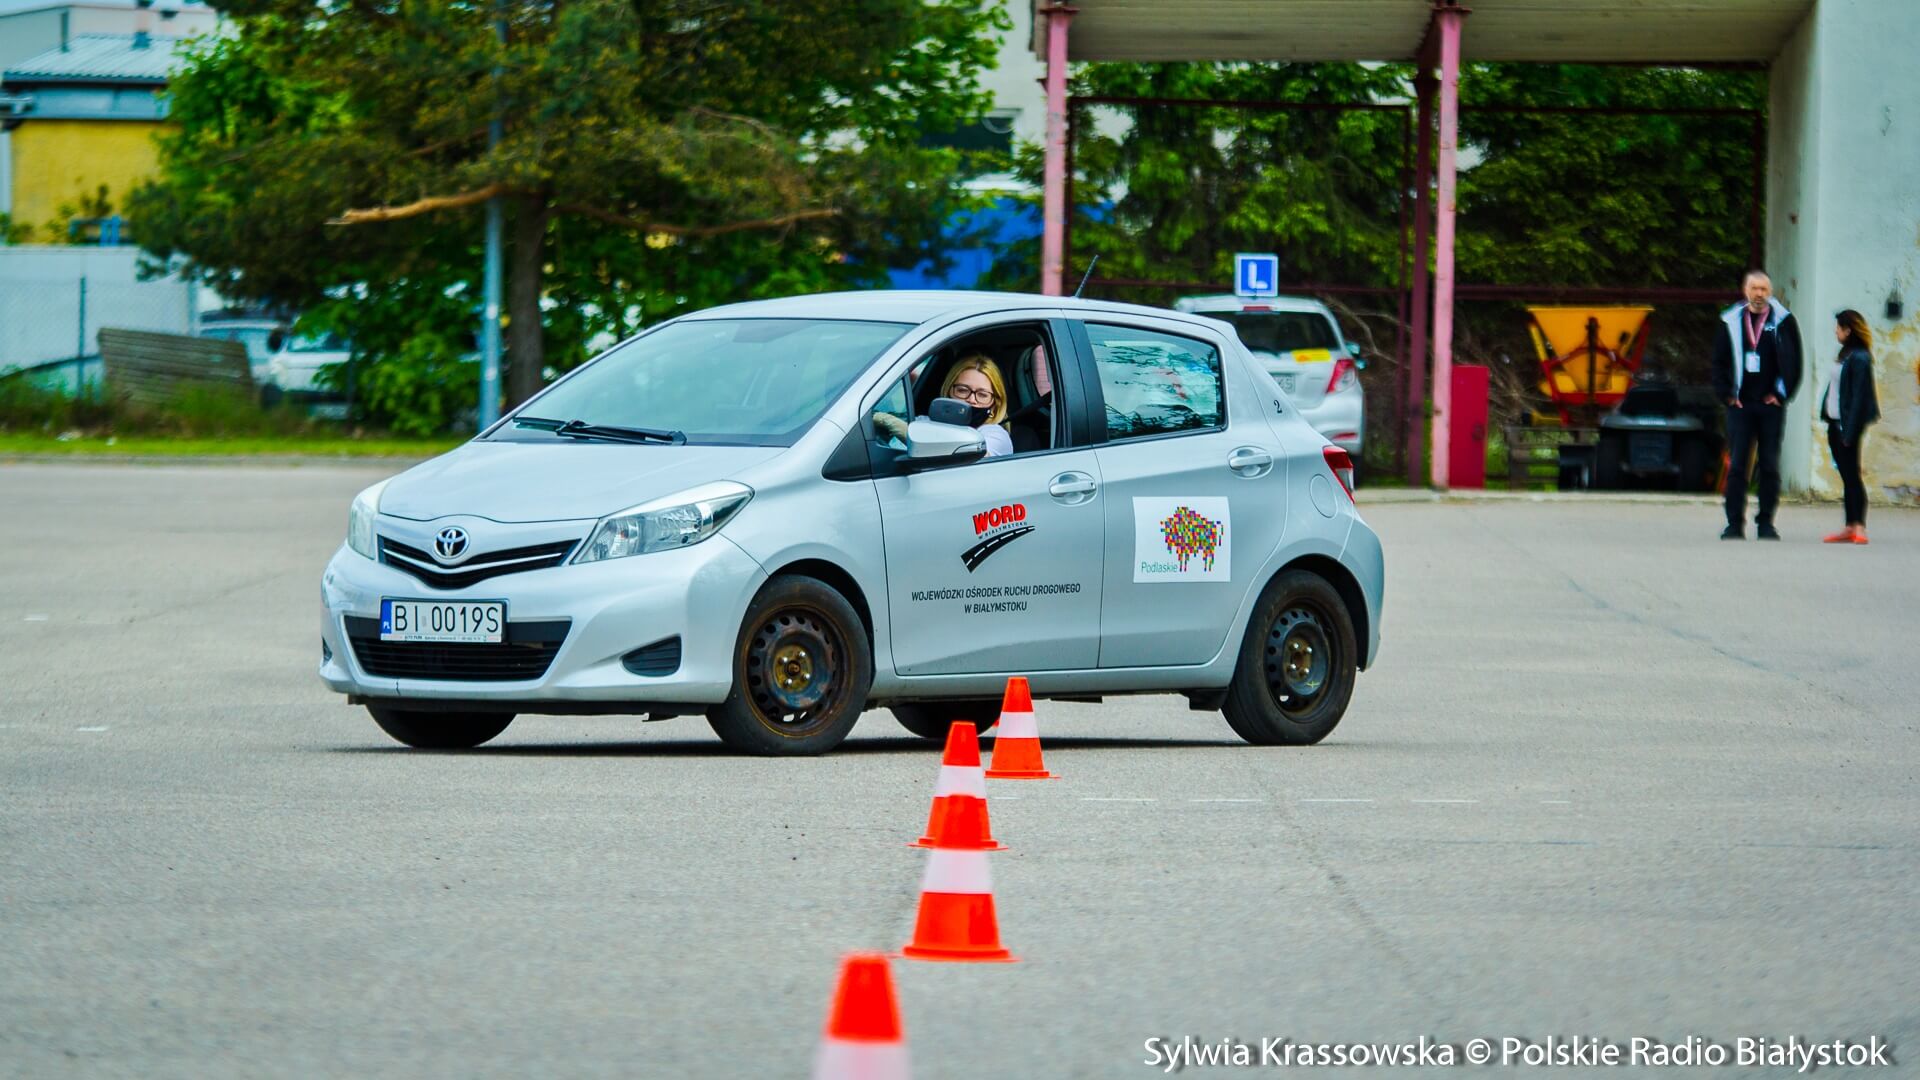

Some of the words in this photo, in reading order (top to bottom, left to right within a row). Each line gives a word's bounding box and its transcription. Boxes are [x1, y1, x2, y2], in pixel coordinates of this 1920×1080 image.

[1248, 261, 1268, 289] L
[973, 503, 1026, 535] WORD
[1141, 561, 1178, 573] Podlaskie
[911, 587, 965, 602] WOJEWÓDZKI
[965, 585, 1003, 599] OŚRODEK
[1004, 585, 1032, 597] RUCHU
[1032, 582, 1081, 595] DROGOWEGO
[395, 605, 419, 632] BI
[431, 606, 499, 633] 0019S
[964, 603, 972, 614] W
[973, 601, 1028, 614] BIAŁYMSTOKU
